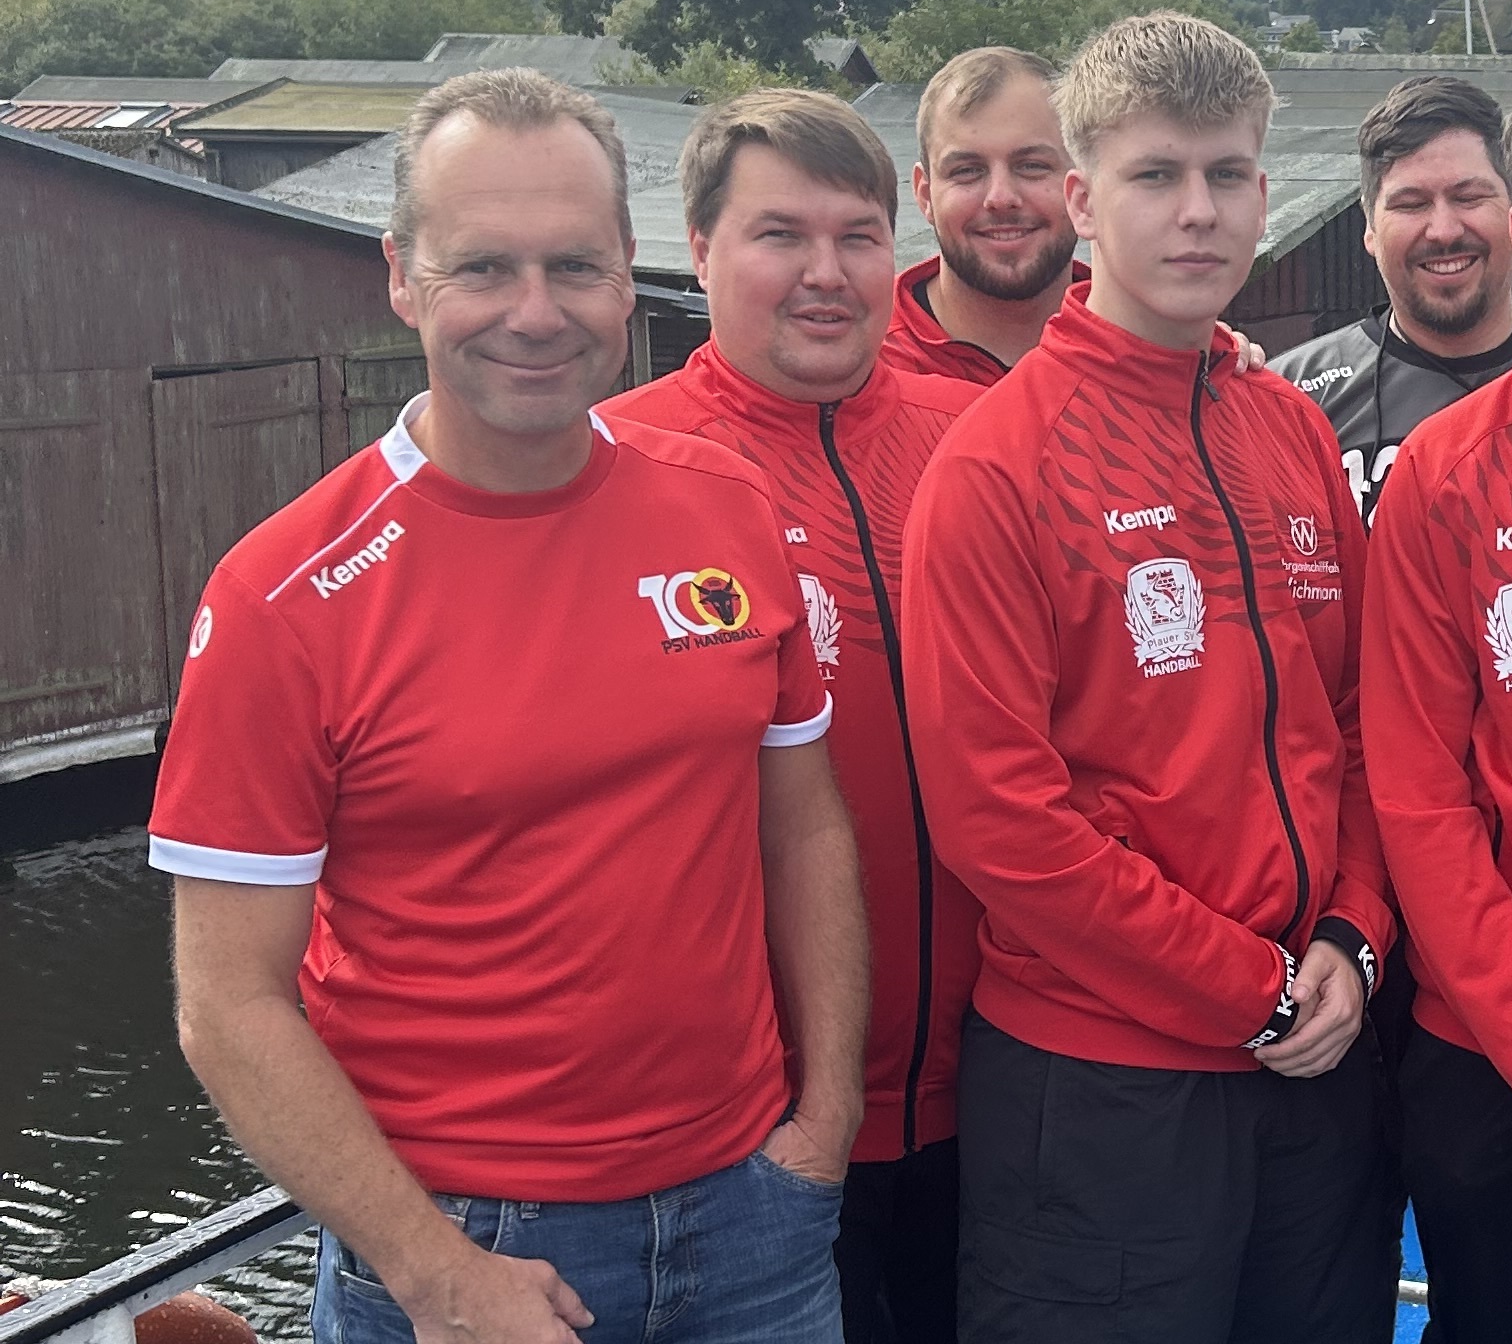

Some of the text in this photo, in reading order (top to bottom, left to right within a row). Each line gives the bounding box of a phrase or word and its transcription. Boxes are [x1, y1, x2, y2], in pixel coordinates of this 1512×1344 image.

[1293, 365, 1354, 393] empa
[1103, 504, 1178, 535] Kempa
[308, 519, 406, 600] Kempa
[694, 627, 766, 648] HANDBALL
[1147, 633, 1179, 649] Plauer
[1143, 656, 1202, 679] HANDBALL
